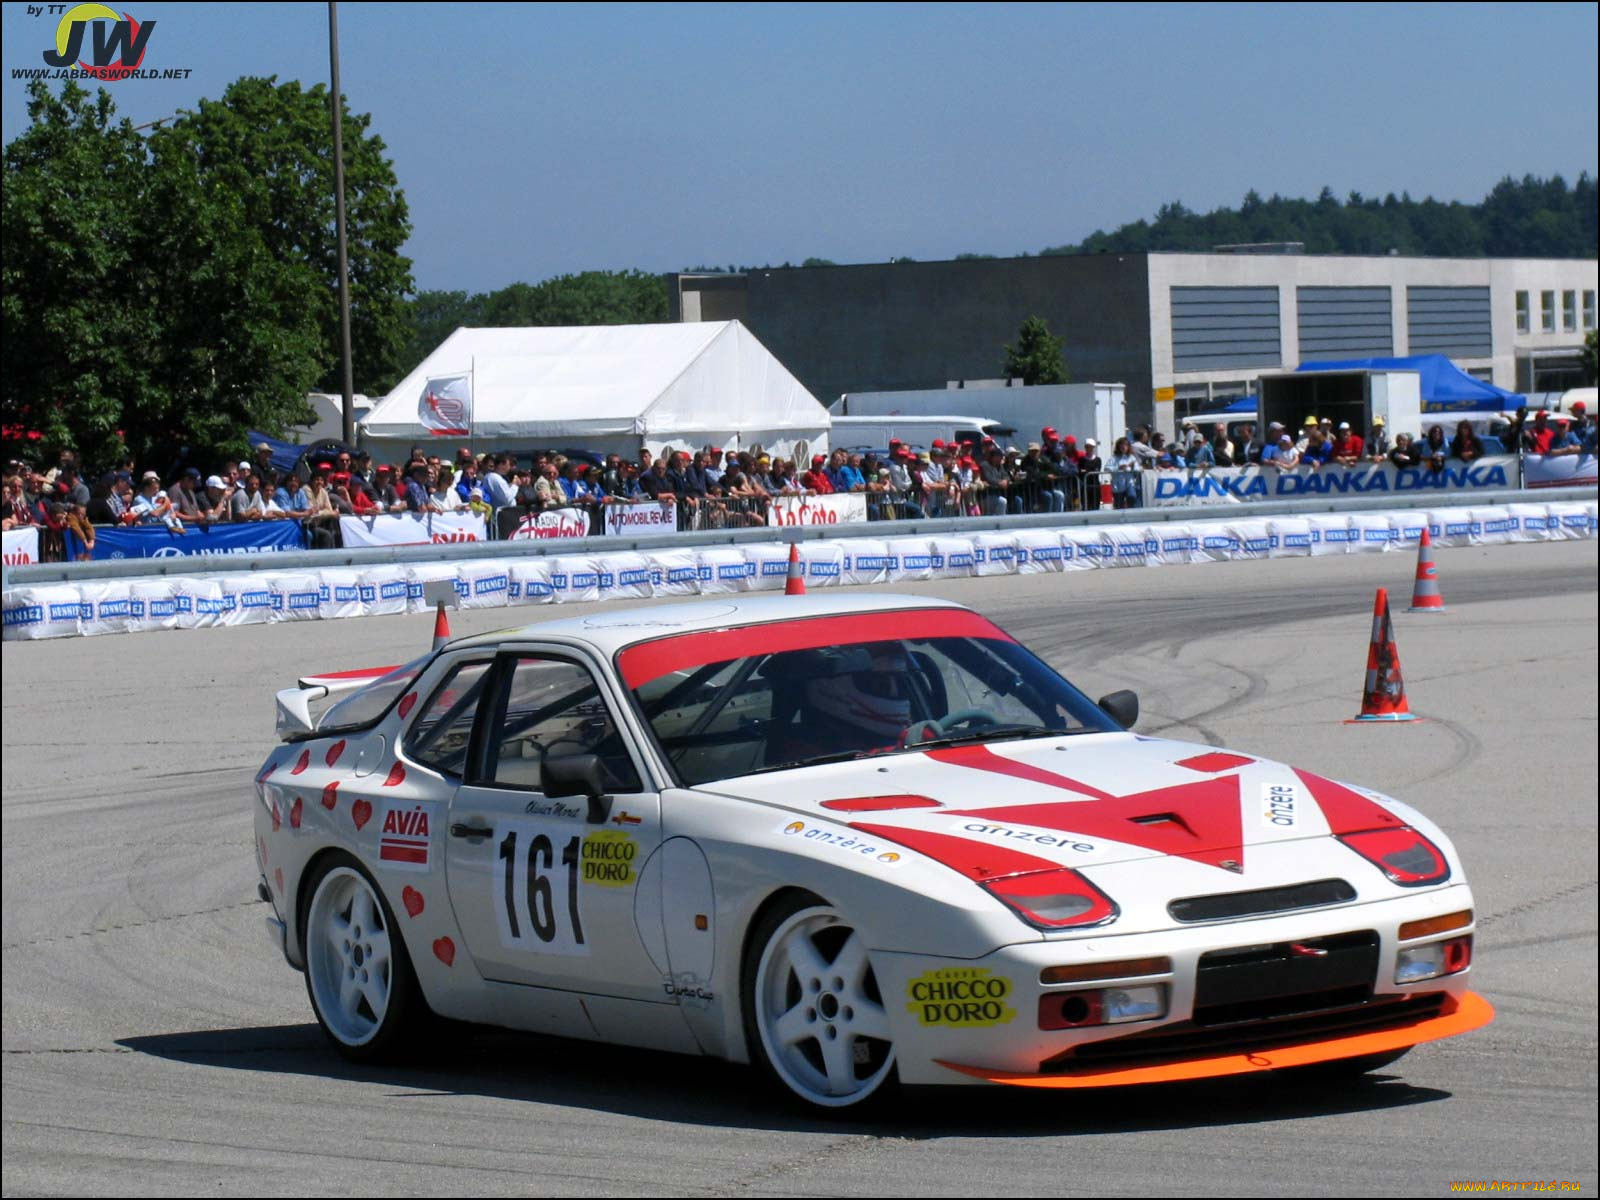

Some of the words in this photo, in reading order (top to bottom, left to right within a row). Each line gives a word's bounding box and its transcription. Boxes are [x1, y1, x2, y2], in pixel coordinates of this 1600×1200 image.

[1155, 475, 1268, 499] DANKA
[1276, 471, 1389, 495] DANKA
[1394, 466, 1507, 490] DANKA
[1265, 786, 1293, 826] anzère
[582, 842, 634, 860] CHICCO
[805, 828, 876, 855] anzère
[964, 824, 1095, 853] anzère
[500, 832, 585, 944] 161
[912, 979, 1005, 1001] CHICCO
